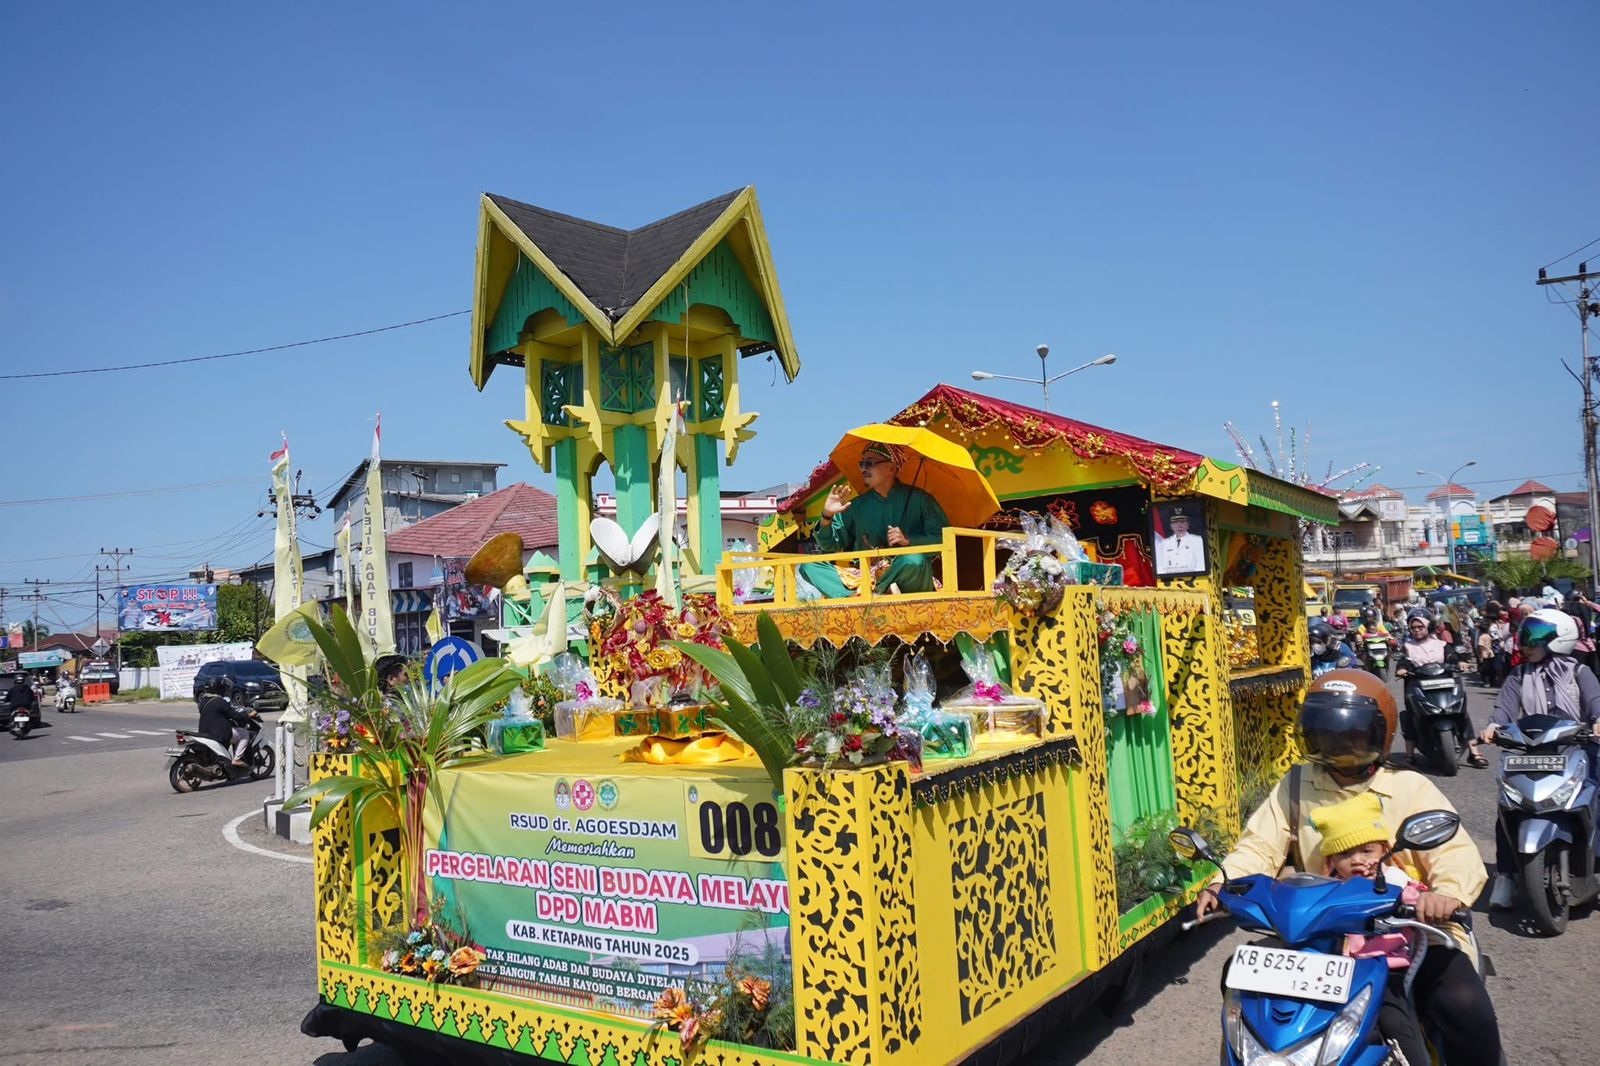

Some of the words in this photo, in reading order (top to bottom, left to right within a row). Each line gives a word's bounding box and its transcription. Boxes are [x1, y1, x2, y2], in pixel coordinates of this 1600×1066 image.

[136, 588, 179, 600] STOP
[510, 814, 548, 829] RSUD
[553, 817, 571, 831] dr.
[575, 818, 677, 838] AGOESDJAM
[699, 801, 781, 857] 008
[546, 836, 635, 858] Memeriahkan
[428, 853, 548, 886] PERGELARAN
[553, 865, 595, 891] SENI
[602, 871, 694, 900] BUDAYA
[538, 894, 578, 919] DPD
[584, 901, 655, 929] MABM
[513, 924, 540, 940] KAB.
[542, 928, 602, 950] KETAPANG
[605, 938, 651, 956] TAHUN
[654, 944, 690, 961] 2025
[486, 948, 505, 961] TAK
[506, 952, 540, 967] HILANG
[542, 958, 568, 972] ADAB
[570, 963, 590, 976] DAN
[592, 968, 638, 983] BUDAYA
[637, 973, 686, 990] DITELAN
[1235, 949, 1259, 966] KB
[1263, 953, 1308, 973] 6254
[1325, 961, 1349, 977] GU
[500, 965, 537, 980] BANGUN
[538, 973, 571, 987] TANAH
[573, 978, 614, 995] KAYONG
[616, 986, 662, 1002] BERGAN
